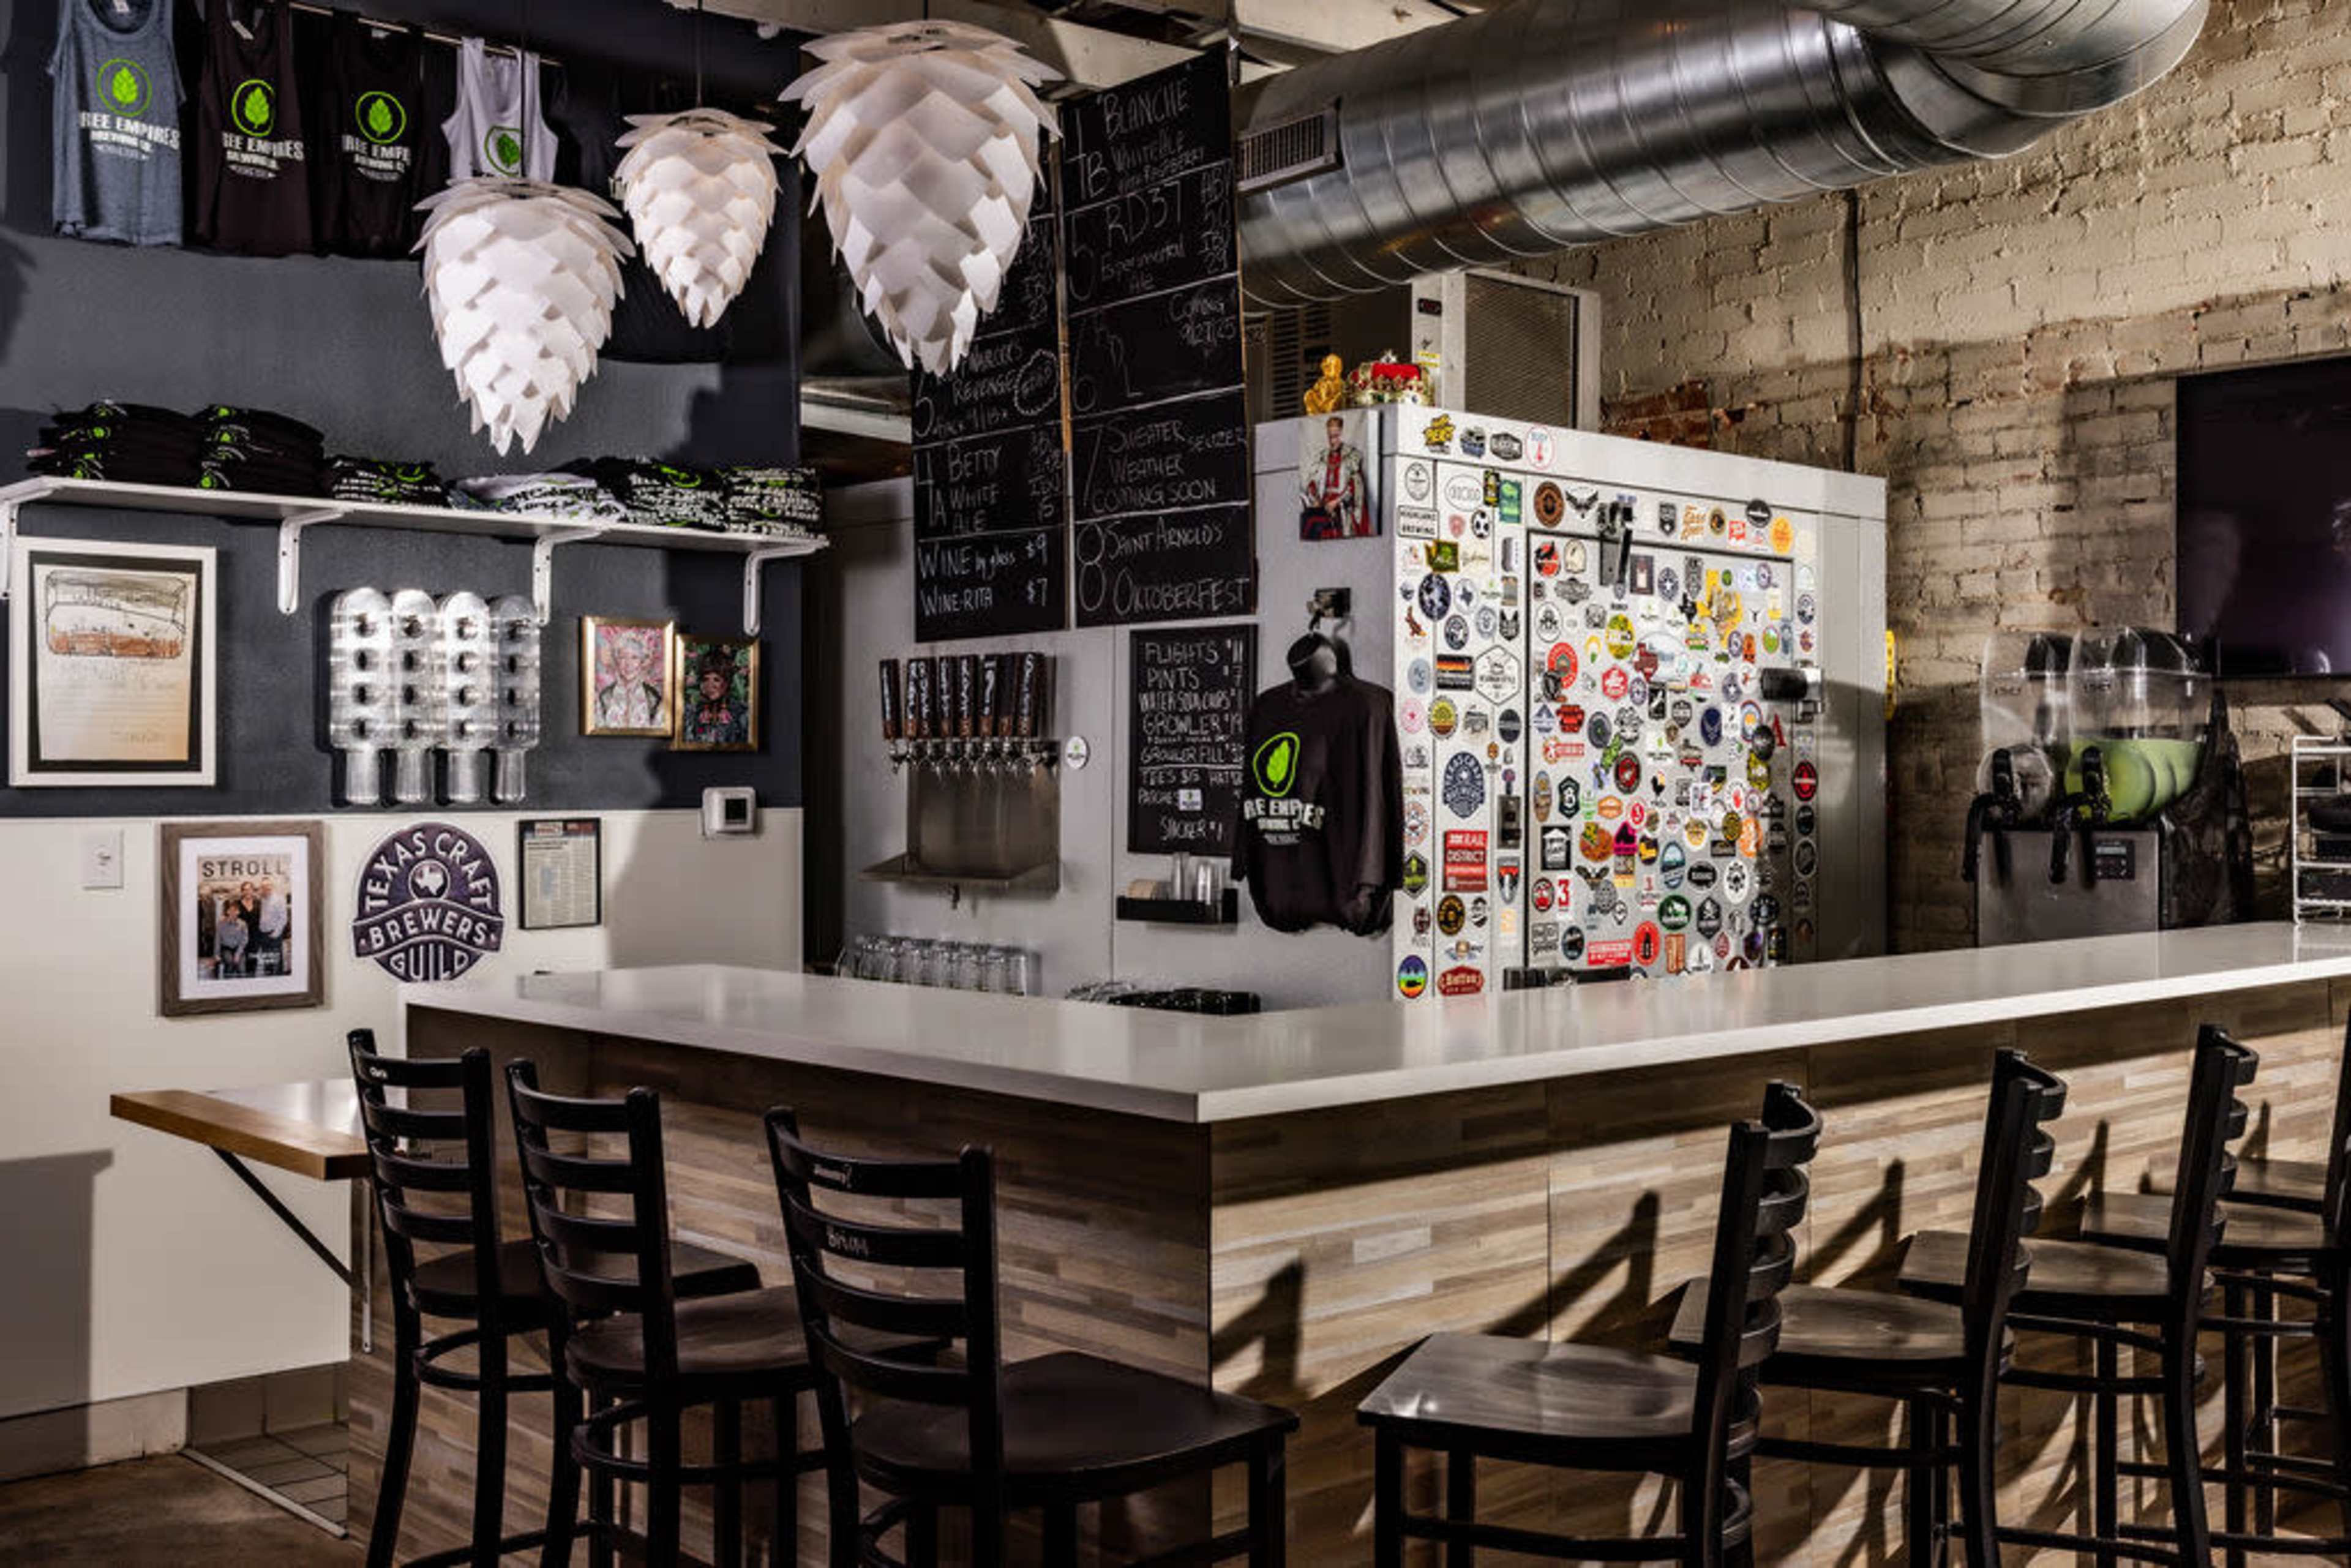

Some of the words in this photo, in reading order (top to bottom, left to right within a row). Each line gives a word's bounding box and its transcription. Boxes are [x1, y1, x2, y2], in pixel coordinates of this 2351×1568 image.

[1103, 78, 1188, 140] BLANCHE
[116, 116, 181, 151] EMPIRES
[948, 438, 1002, 483] BETTY
[1166, 478, 1217, 504] SOON
[918, 539, 973, 580] WINE
[1076, 522, 1106, 612] 8
[1027, 577, 1049, 608] $7
[1112, 569, 1251, 617] OKTOBERFEST
[1144, 640, 1220, 666] FLIGHTS
[1147, 666, 1200, 691] PINTS
[1142, 711, 1223, 737] GROWLER
[202, 859, 286, 878] STROLL
[365, 830, 427, 912] TEXAS
[434, 831, 492, 911] CRAFT
[369, 907, 488, 949] BREWERS
[390, 943, 470, 980] GUILD
